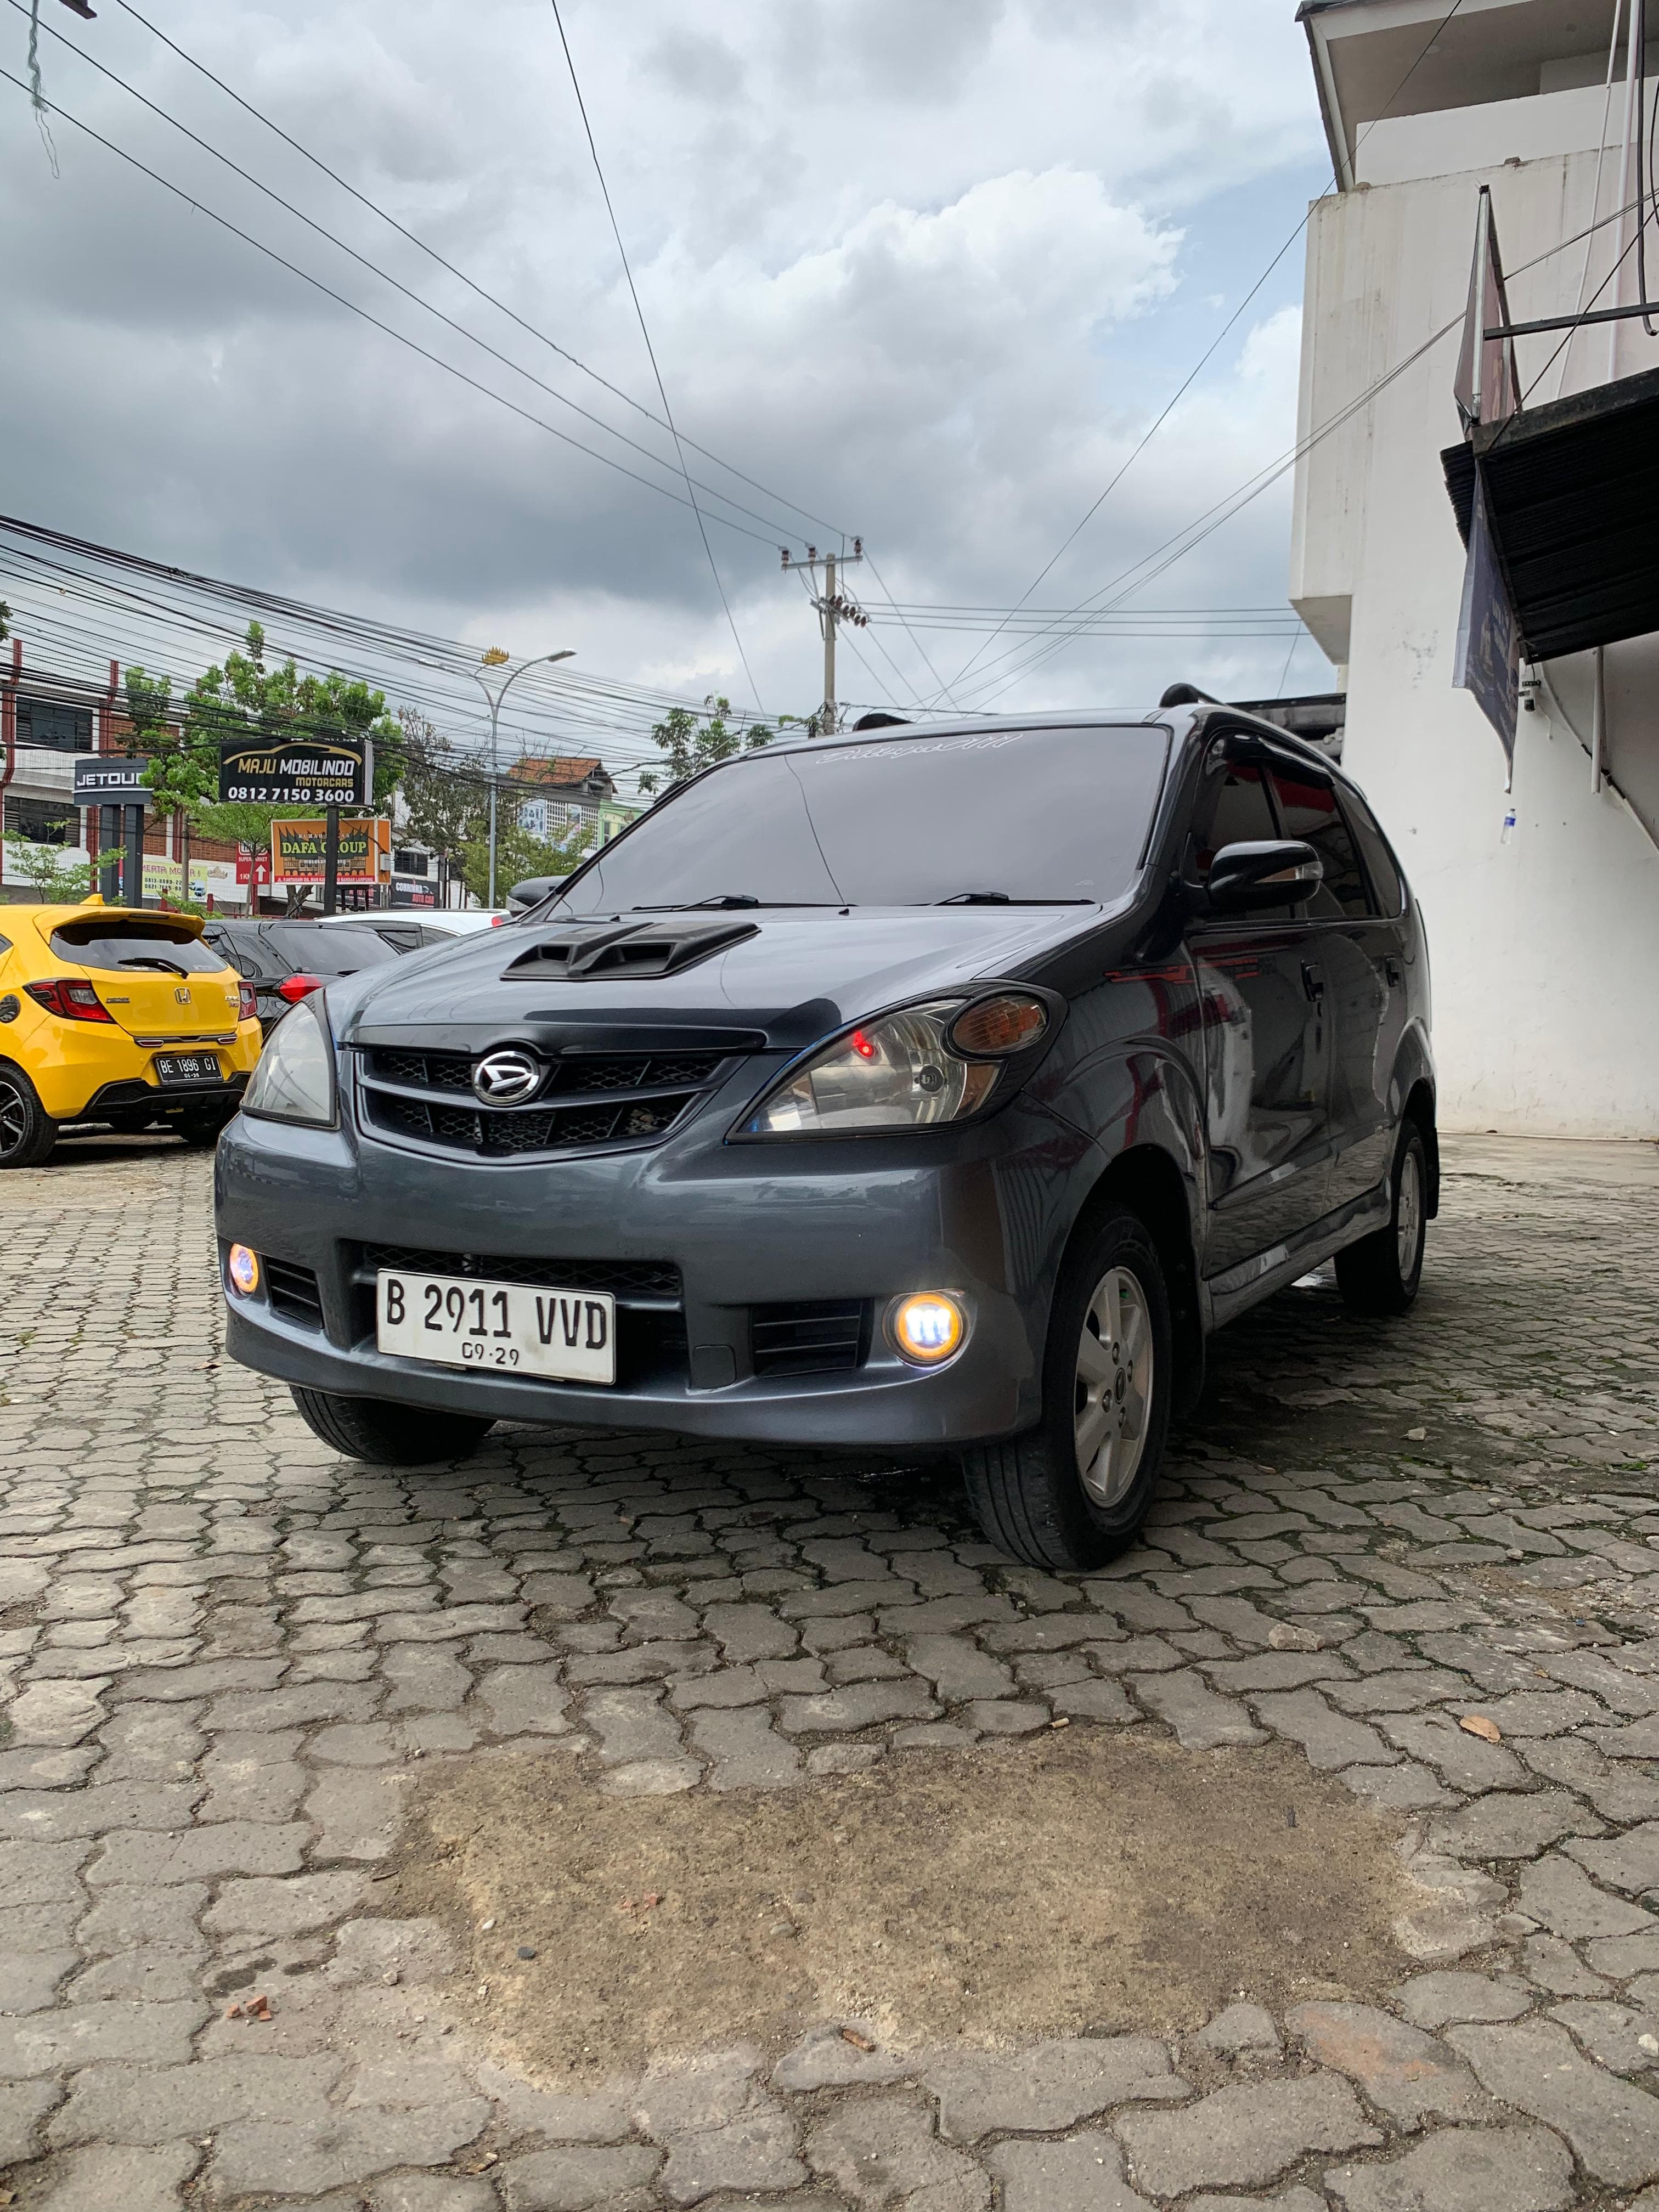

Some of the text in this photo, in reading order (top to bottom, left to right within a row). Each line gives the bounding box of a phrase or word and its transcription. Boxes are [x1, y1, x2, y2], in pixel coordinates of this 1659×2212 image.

[238, 758, 355, 776] MAJU MOBILINDO
[295, 777, 354, 788] MOTORCARS
[228, 787, 354, 802] 0812 7150 3600
[282, 841, 367, 854] DAFA GOUP
[160, 1057, 216, 1073] BE 1896 GI
[387, 1278, 606, 1349] B 2911 VVD
